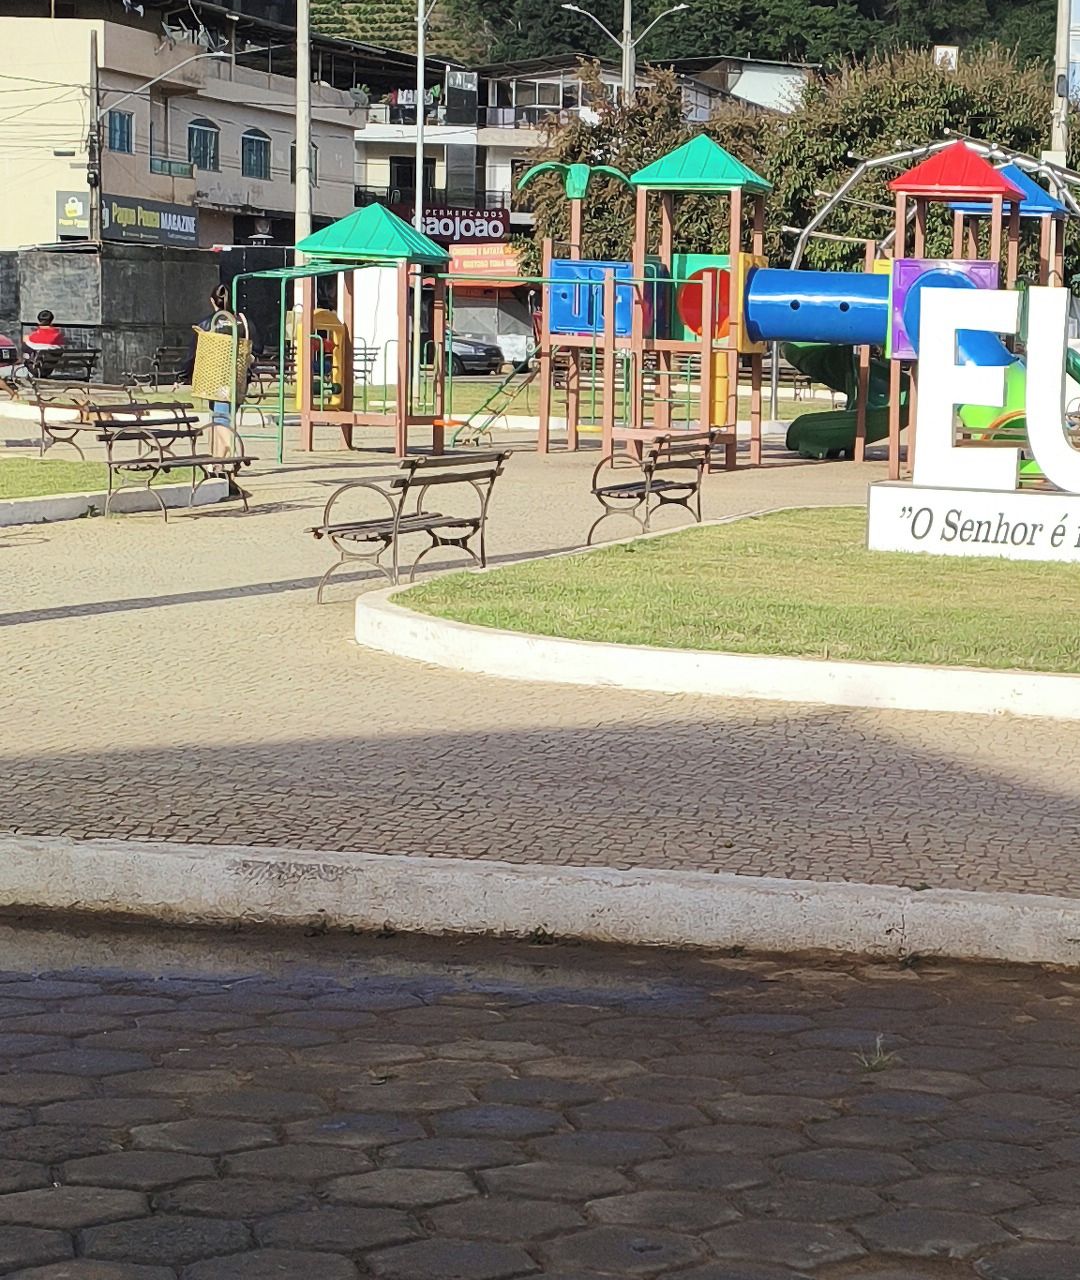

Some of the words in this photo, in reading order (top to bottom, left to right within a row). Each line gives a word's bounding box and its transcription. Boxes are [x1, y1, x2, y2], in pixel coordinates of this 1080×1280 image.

[160, 212, 196, 233] MAGAZINE
[411, 208, 504, 218] SPERMERCADOS
[940, 508, 1043, 547] Senhor
[1050, 513, 1069, 548] é
